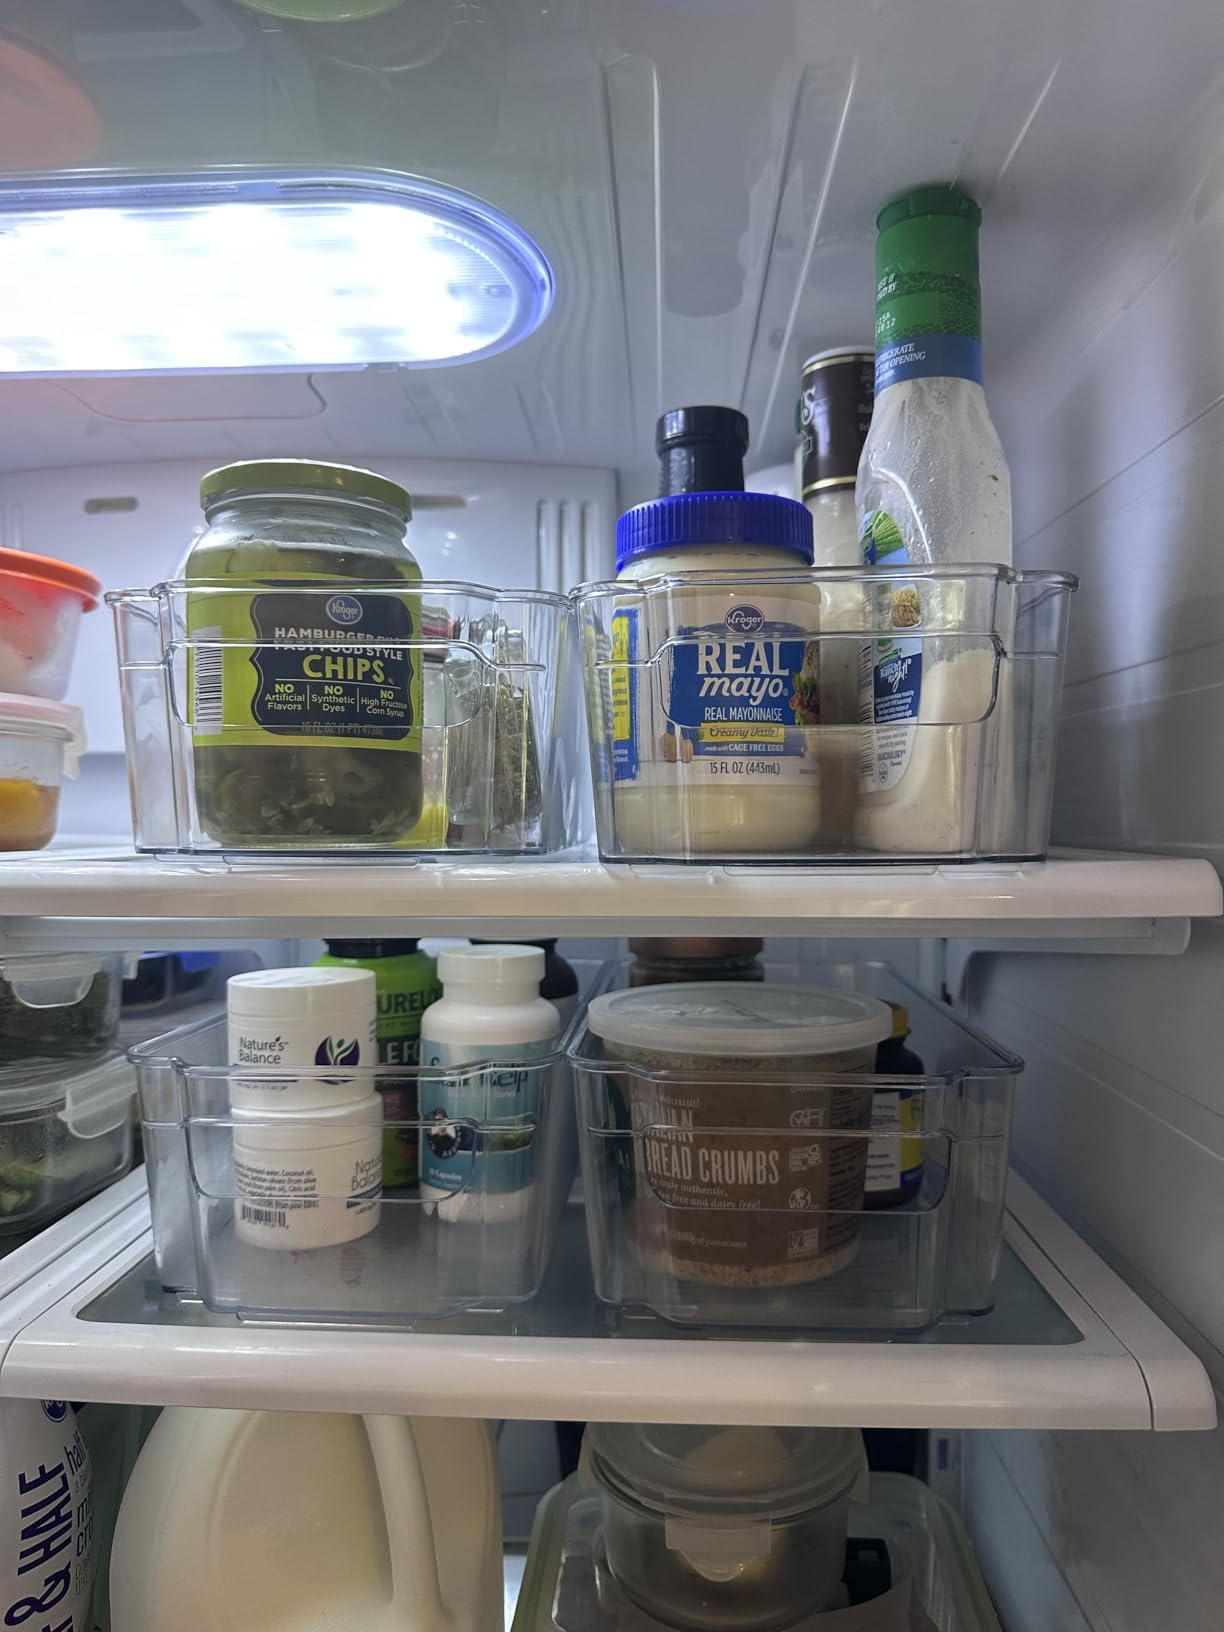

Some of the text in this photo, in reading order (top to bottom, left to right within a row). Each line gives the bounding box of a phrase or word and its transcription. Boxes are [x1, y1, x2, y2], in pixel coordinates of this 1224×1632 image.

[890, 352, 926, 368] OPENING
[333, 600, 358, 619] Kroger
[727, 611, 762, 629] Kroger
[366, 646, 404, 661] STYLE
[697, 639, 789, 676] REAL
[303, 654, 384, 683] CHIPS
[275, 683, 294, 694] NO
[324, 685, 343, 695] NO
[380, 689, 394, 700] NO
[265, 693, 305, 703] Artificial
[311, 694, 355, 706] Synthetic
[361, 697, 408, 711] High Fructose
[268, 702, 302, 711] Flavors
[322, 703, 345, 713] Dyes
[366, 706, 405, 718] Corn Syrup
[705, 707, 783, 722] REAL MAYONNAISE
[710, 726, 748, 739] Creamy
[728, 743, 748, 752] CAGE
[750, 744, 767, 752] FREE
[710, 762, 718, 774] 15
[720, 762, 730, 774] FL
[732, 762, 743, 774] OZ
[240, 1036, 285, 1051] Nature's
[239, 1050, 281, 1064] Balance
[699, 1149, 780, 1185] CRUMBS
[17, 1461, 73, 1577] HALF
[4, 1560, 71, 1627] &
